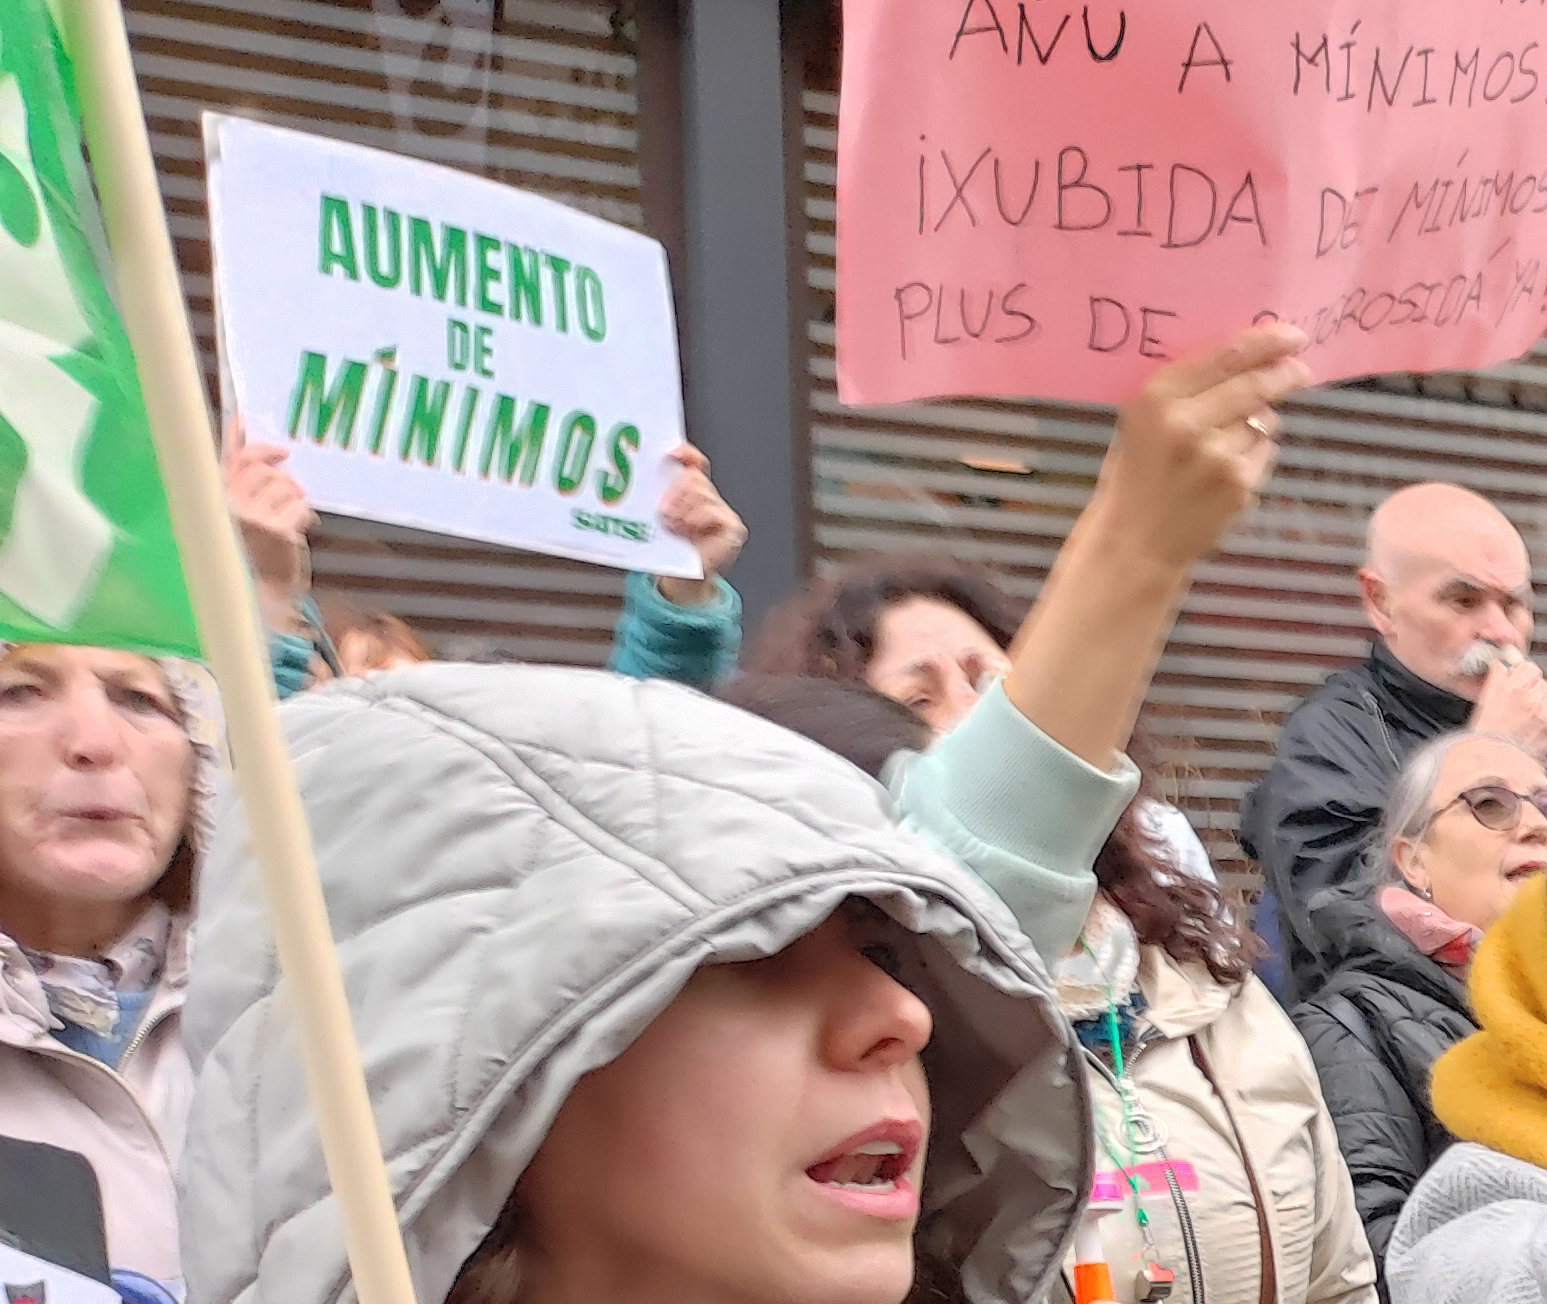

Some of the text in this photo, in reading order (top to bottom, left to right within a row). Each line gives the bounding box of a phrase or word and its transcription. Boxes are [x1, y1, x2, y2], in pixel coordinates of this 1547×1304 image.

[1177, 21, 1234, 95] A
[1316, 186, 1380, 260] DE
[317, 194, 606, 344] AUMENTO
[446, 317, 496, 379] DE
[893, 281, 1038, 361] PLUS
[1088, 294, 1178, 360] DE
[287, 346, 641, 506] MÍNIMOS
